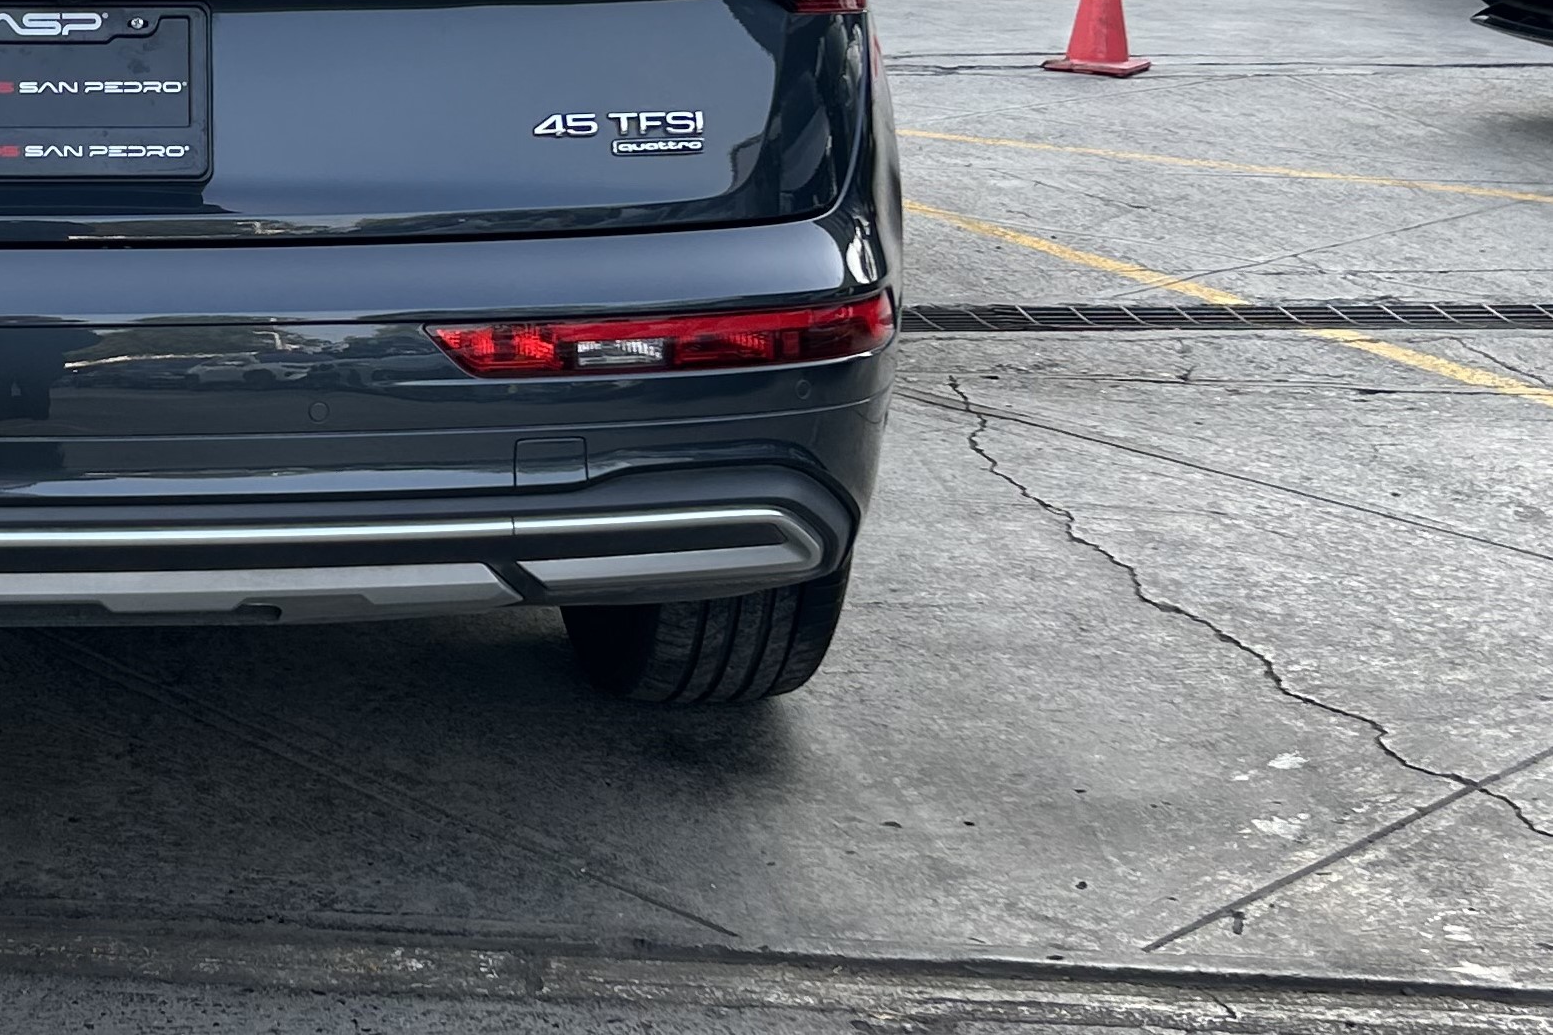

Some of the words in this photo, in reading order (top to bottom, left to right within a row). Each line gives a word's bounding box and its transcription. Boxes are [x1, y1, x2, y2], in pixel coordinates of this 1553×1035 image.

[18, 80, 79, 95] SAN
[83, 80, 183, 95] PEDRO
[533, 113, 599, 137] 45
[607, 111, 704, 136] TFSI
[23, 144, 84, 159] SAN
[88, 144, 185, 159] PEDRO
[617, 140, 703, 153] quattro
